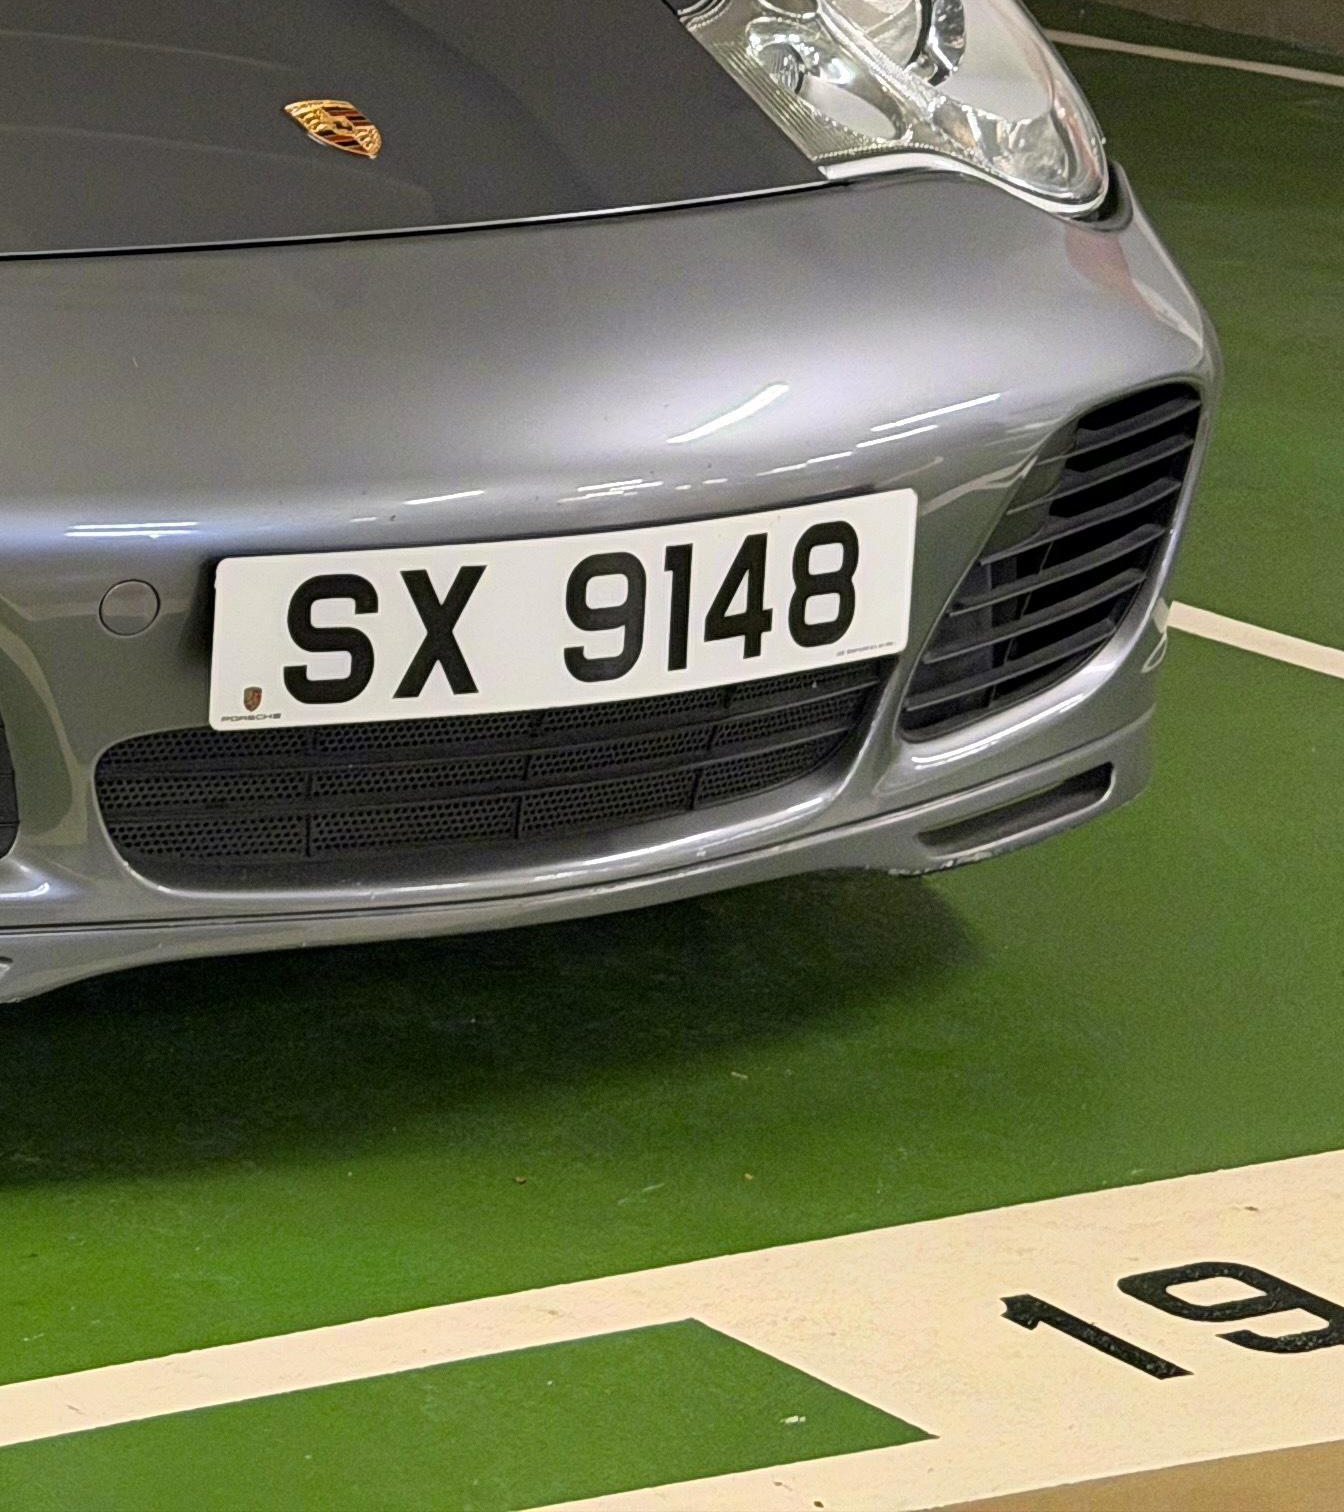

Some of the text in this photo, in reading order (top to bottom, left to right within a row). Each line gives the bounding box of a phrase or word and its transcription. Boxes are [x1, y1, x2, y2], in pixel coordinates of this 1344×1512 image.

[282, 520, 860, 705] SX 9148
[1000, 1261, 1344, 1381] 19
